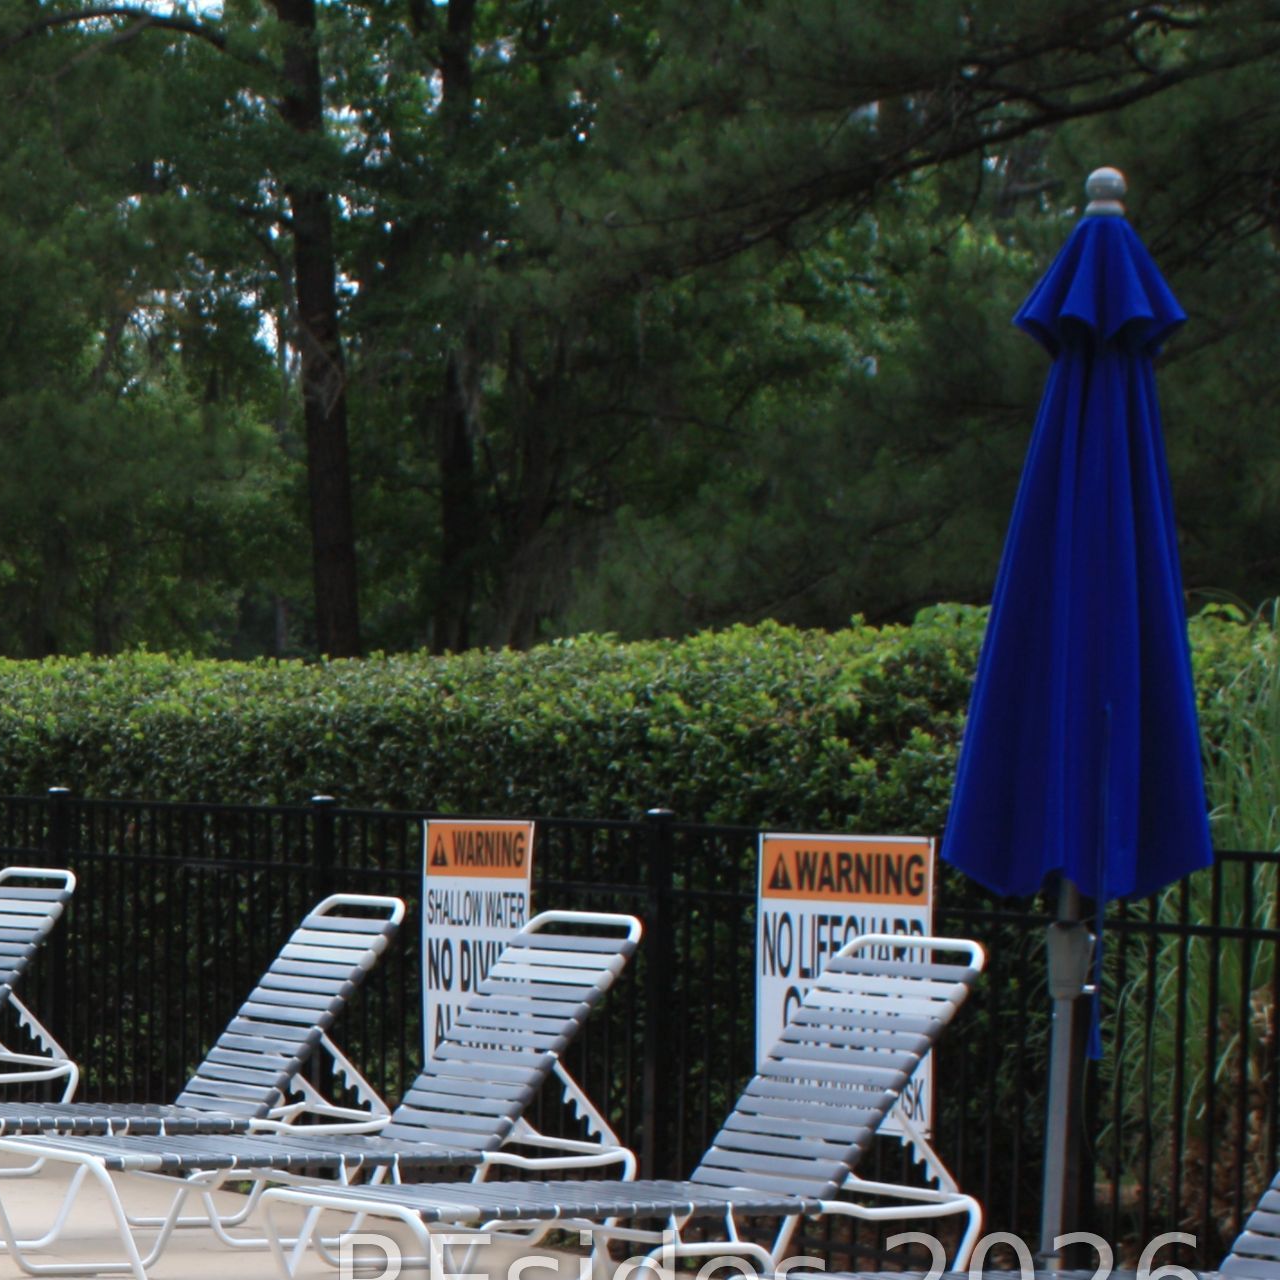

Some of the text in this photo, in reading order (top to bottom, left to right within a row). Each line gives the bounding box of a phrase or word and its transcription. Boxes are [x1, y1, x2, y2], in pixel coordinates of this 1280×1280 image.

[452, 831, 525, 868] WARNING
[795, 851, 925, 896] WARNING
[427, 889, 525, 929] SHALLOW WATER
[428, 938, 512, 993] NO DIV
[763, 911, 793, 978] NO
